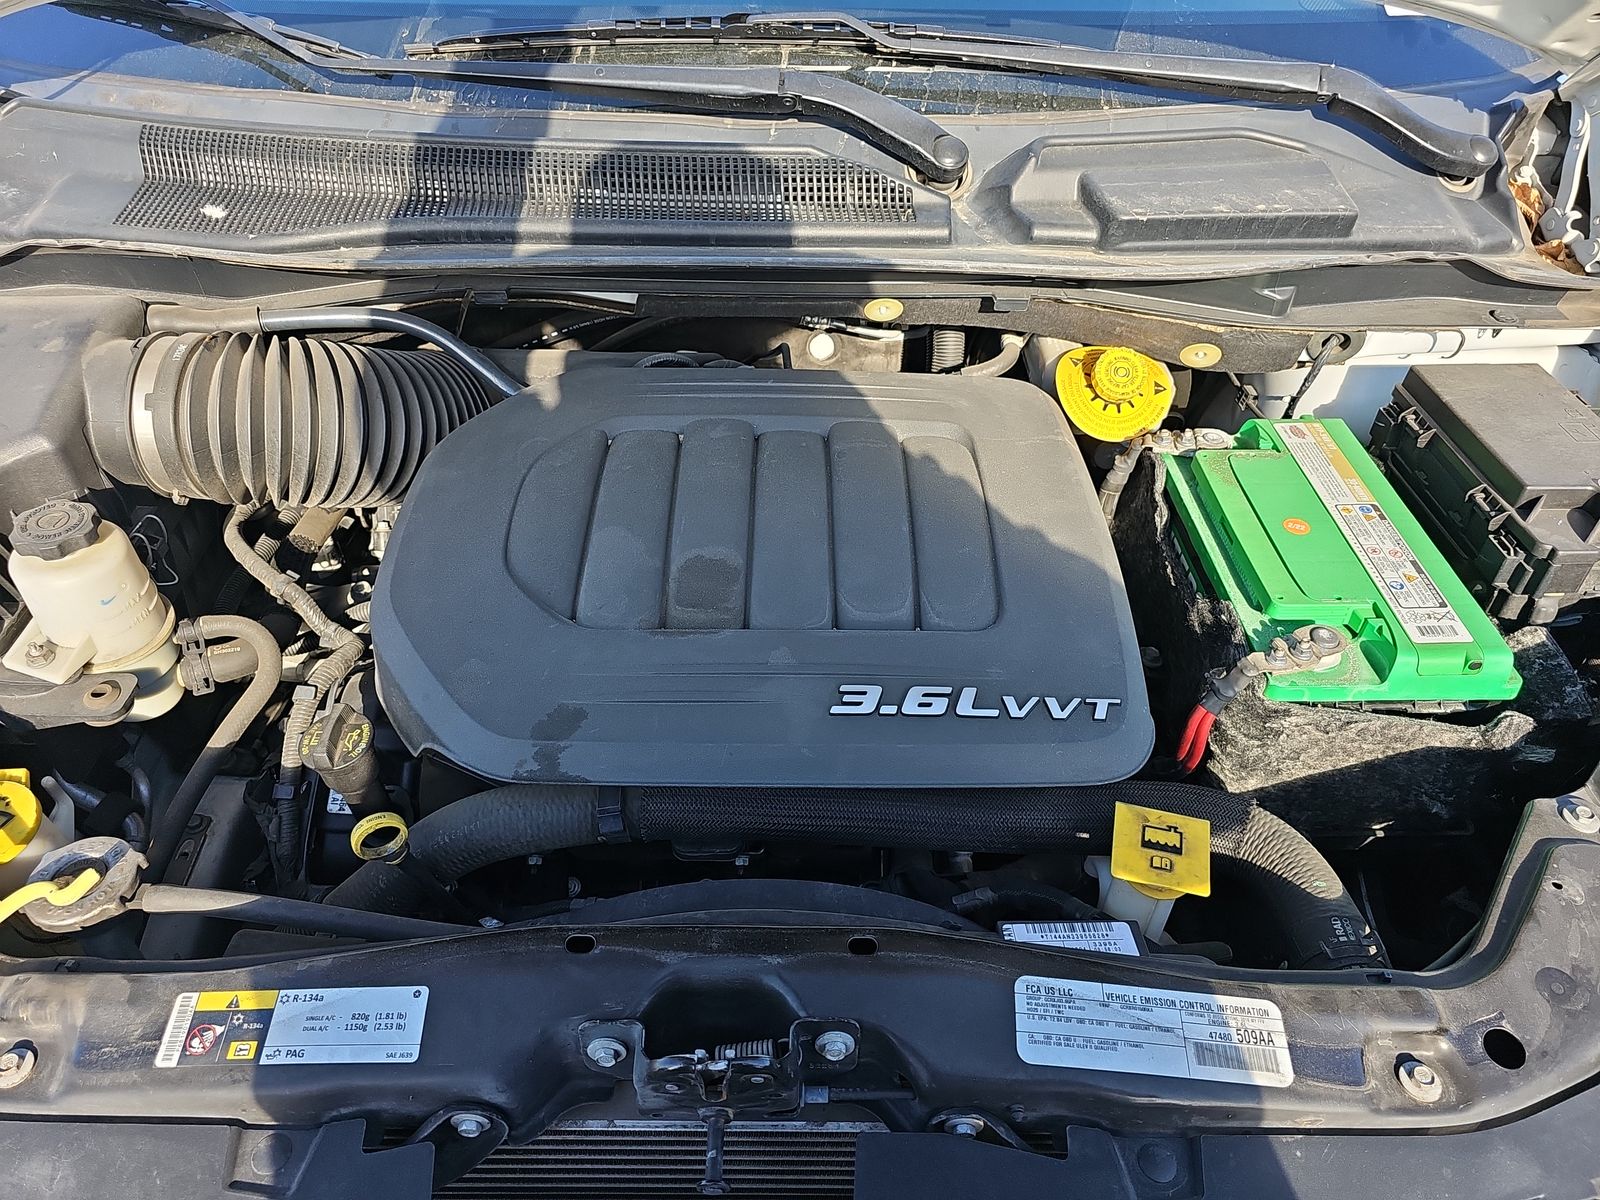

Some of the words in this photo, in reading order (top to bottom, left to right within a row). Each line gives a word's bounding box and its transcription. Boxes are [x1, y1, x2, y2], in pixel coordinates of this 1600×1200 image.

[1025, 984, 1041, 994] FCA
[1044, 986, 1056, 995] US
[1058, 988, 1073, 997] LLC
[293, 994, 324, 1003] R-134a
[1034, 1002, 1067, 1010] ADJUSTMENTS
[1105, 992, 1137, 1004] VEHICLE
[1139, 996, 1177, 1008] EMISSION
[1179, 1000, 1214, 1012] CONTROL
[1216, 1004, 1270, 1017] INFORMATION
[351, 1012, 370, 1022] 820g
[375, 1011, 395, 1021] (1.81
[396, 1011, 408, 1021] lb)
[344, 1022, 368, 1032] 1150g
[374, 1022, 394, 1032] (2.53
[395, 1022, 406, 1032] lb)
[1208, 1031, 1233, 1042] 47480
[1236, 1028, 1276, 1046] 509AA
[285, 1049, 305, 1058] PAG
[398, 1051, 413, 1059] J639
